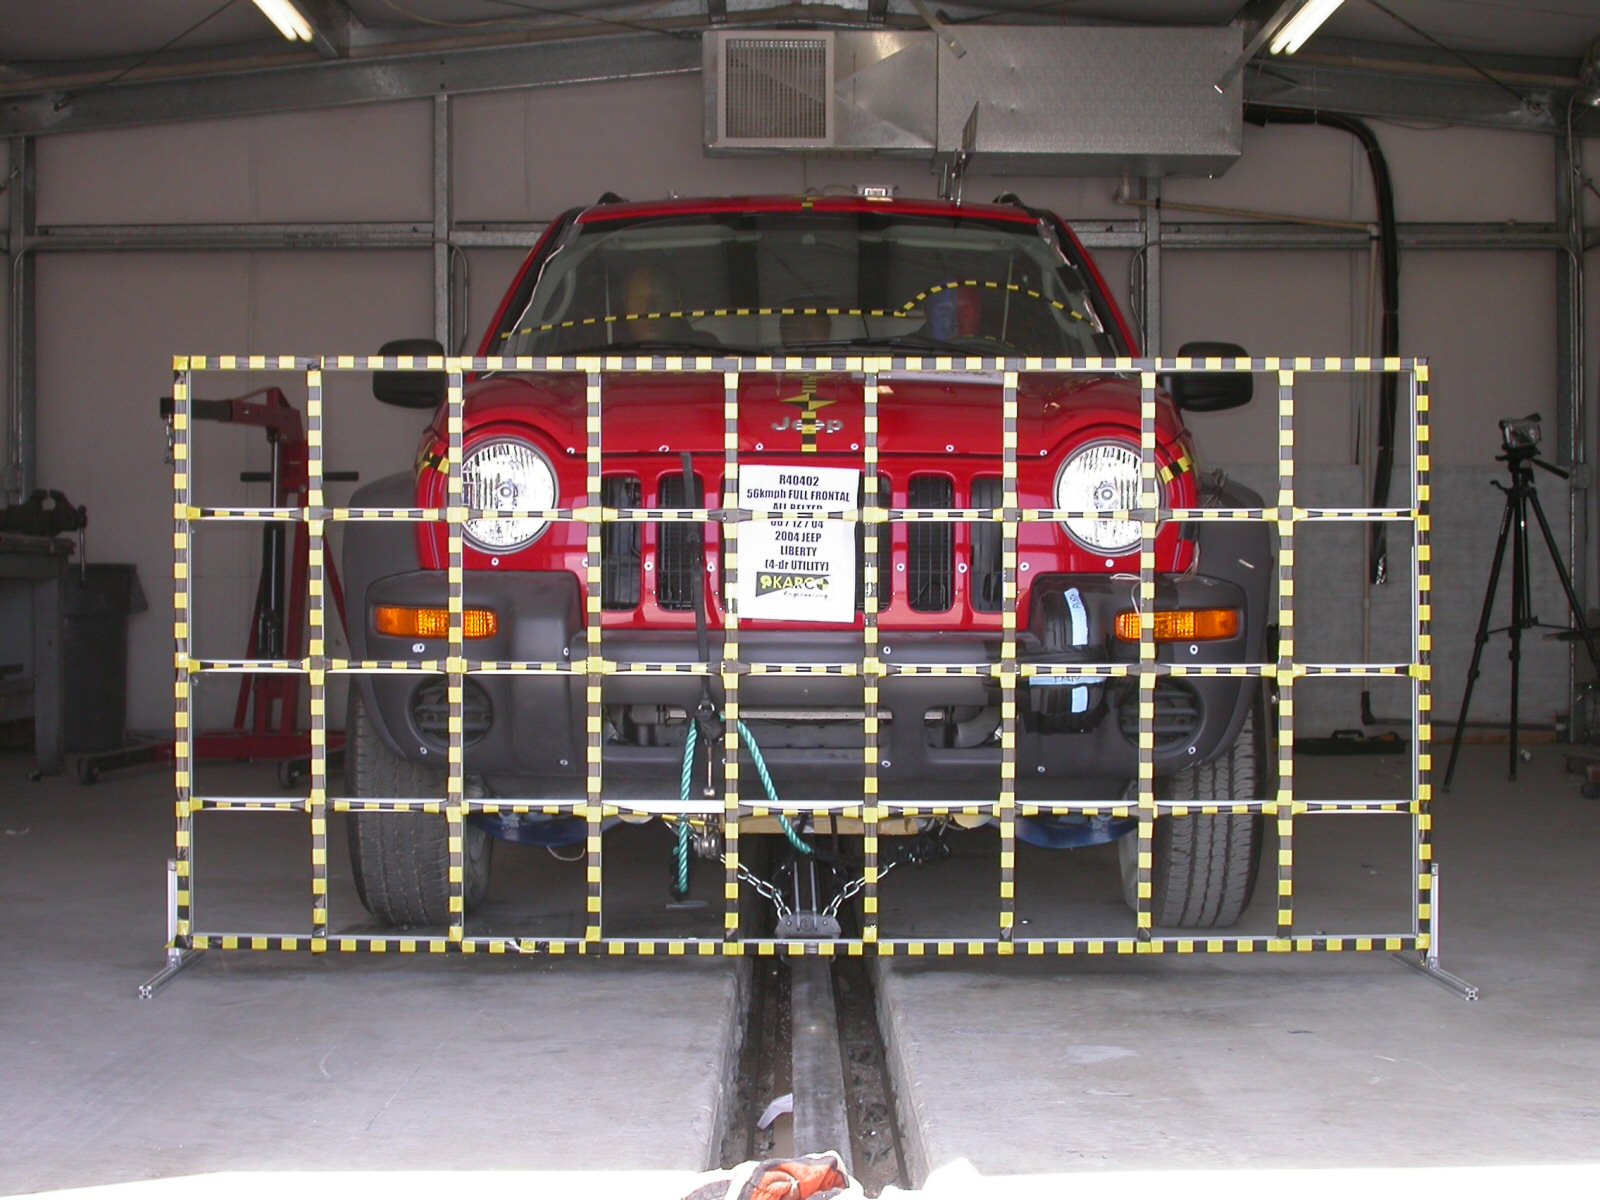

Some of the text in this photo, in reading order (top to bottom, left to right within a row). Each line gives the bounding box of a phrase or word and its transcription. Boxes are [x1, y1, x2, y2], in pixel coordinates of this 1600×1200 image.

[771, 417, 844, 434] Jeep
[779, 474, 820, 487] R40402
[746, 488, 850, 502] 56kmph FULL FRONTAL
[775, 530, 822, 543] 2004 JEEP
[780, 545, 817, 557] LIBERTY
[765, 559, 829, 572] (4-dr UTILITY)
